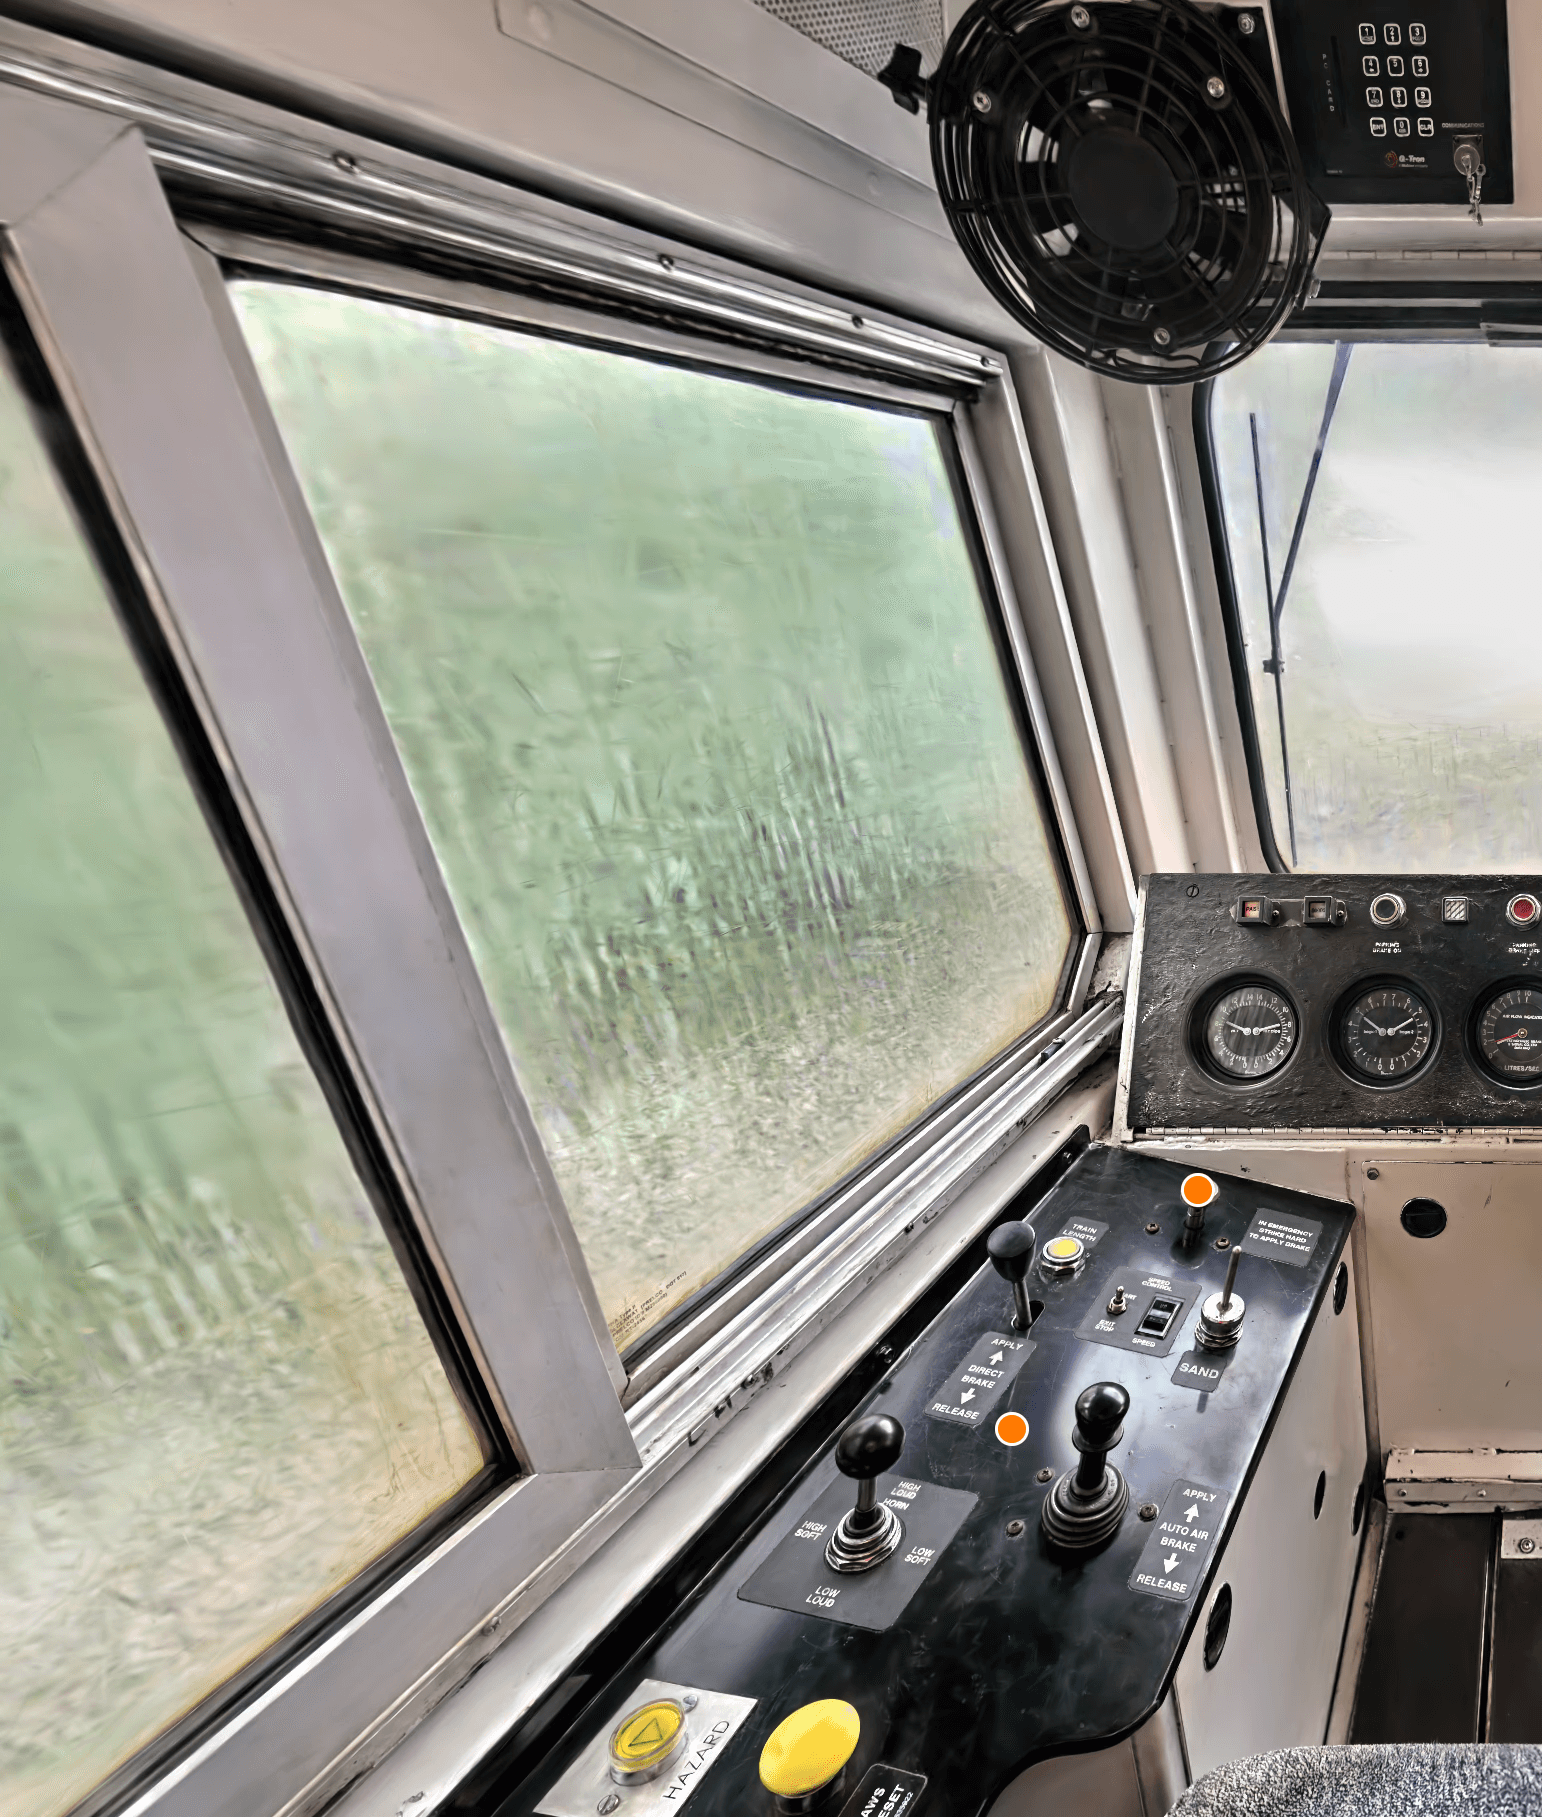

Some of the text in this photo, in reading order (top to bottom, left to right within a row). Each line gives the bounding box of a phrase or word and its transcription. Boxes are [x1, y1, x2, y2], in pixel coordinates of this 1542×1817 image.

[1072, 1223, 1098, 1234] TRAIN
[1258, 1227, 1307, 1243] STRIKE HARD
[1267, 1222, 1314, 1238] EMERGENCY
[1062, 1229, 1097, 1242] LENGTH
[1259, 1235, 1284, 1246] APPLY
[1284, 1241, 1311, 1252] BRAKE
[1141, 1280, 1173, 1292] CONTROL
[1147, 1277, 1171, 1286] SPEED
[1094, 1324, 1115, 1332] STOP
[1098, 1319, 1116, 1327] EXIT
[990, 1338, 1024, 1351] APPLY
[1131, 1337, 1156, 1347] SPEED
[967, 1364, 1005, 1379] DIRECT
[1179, 1361, 1220, 1381] SAND
[960, 1374, 996, 1389] BRAKE
[931, 1402, 980, 1420] RELEASE
[898, 1480, 922, 1493] HIGH
[890, 1488, 917, 1500] LOUD
[1182, 1488, 1217, 1503] APPLY
[882, 1497, 910, 1511] HORN
[801, 1520, 828, 1533] HIGH
[1158, 1521, 1209, 1541] AUTO AIR
[794, 1528, 822, 1541] SOFT
[1159, 1536, 1198, 1553] BRAKE
[911, 1545, 936, 1558] LOW
[904, 1554, 932, 1566] SOFT
[1135, 1573, 1188, 1594] RELEASE
[814, 1585, 841, 1598] LOW
[805, 1593, 836, 1608] LOUD
[662, 1720, 730, 1799] HAZARD
[860, 1786, 886, 1817] AWS
